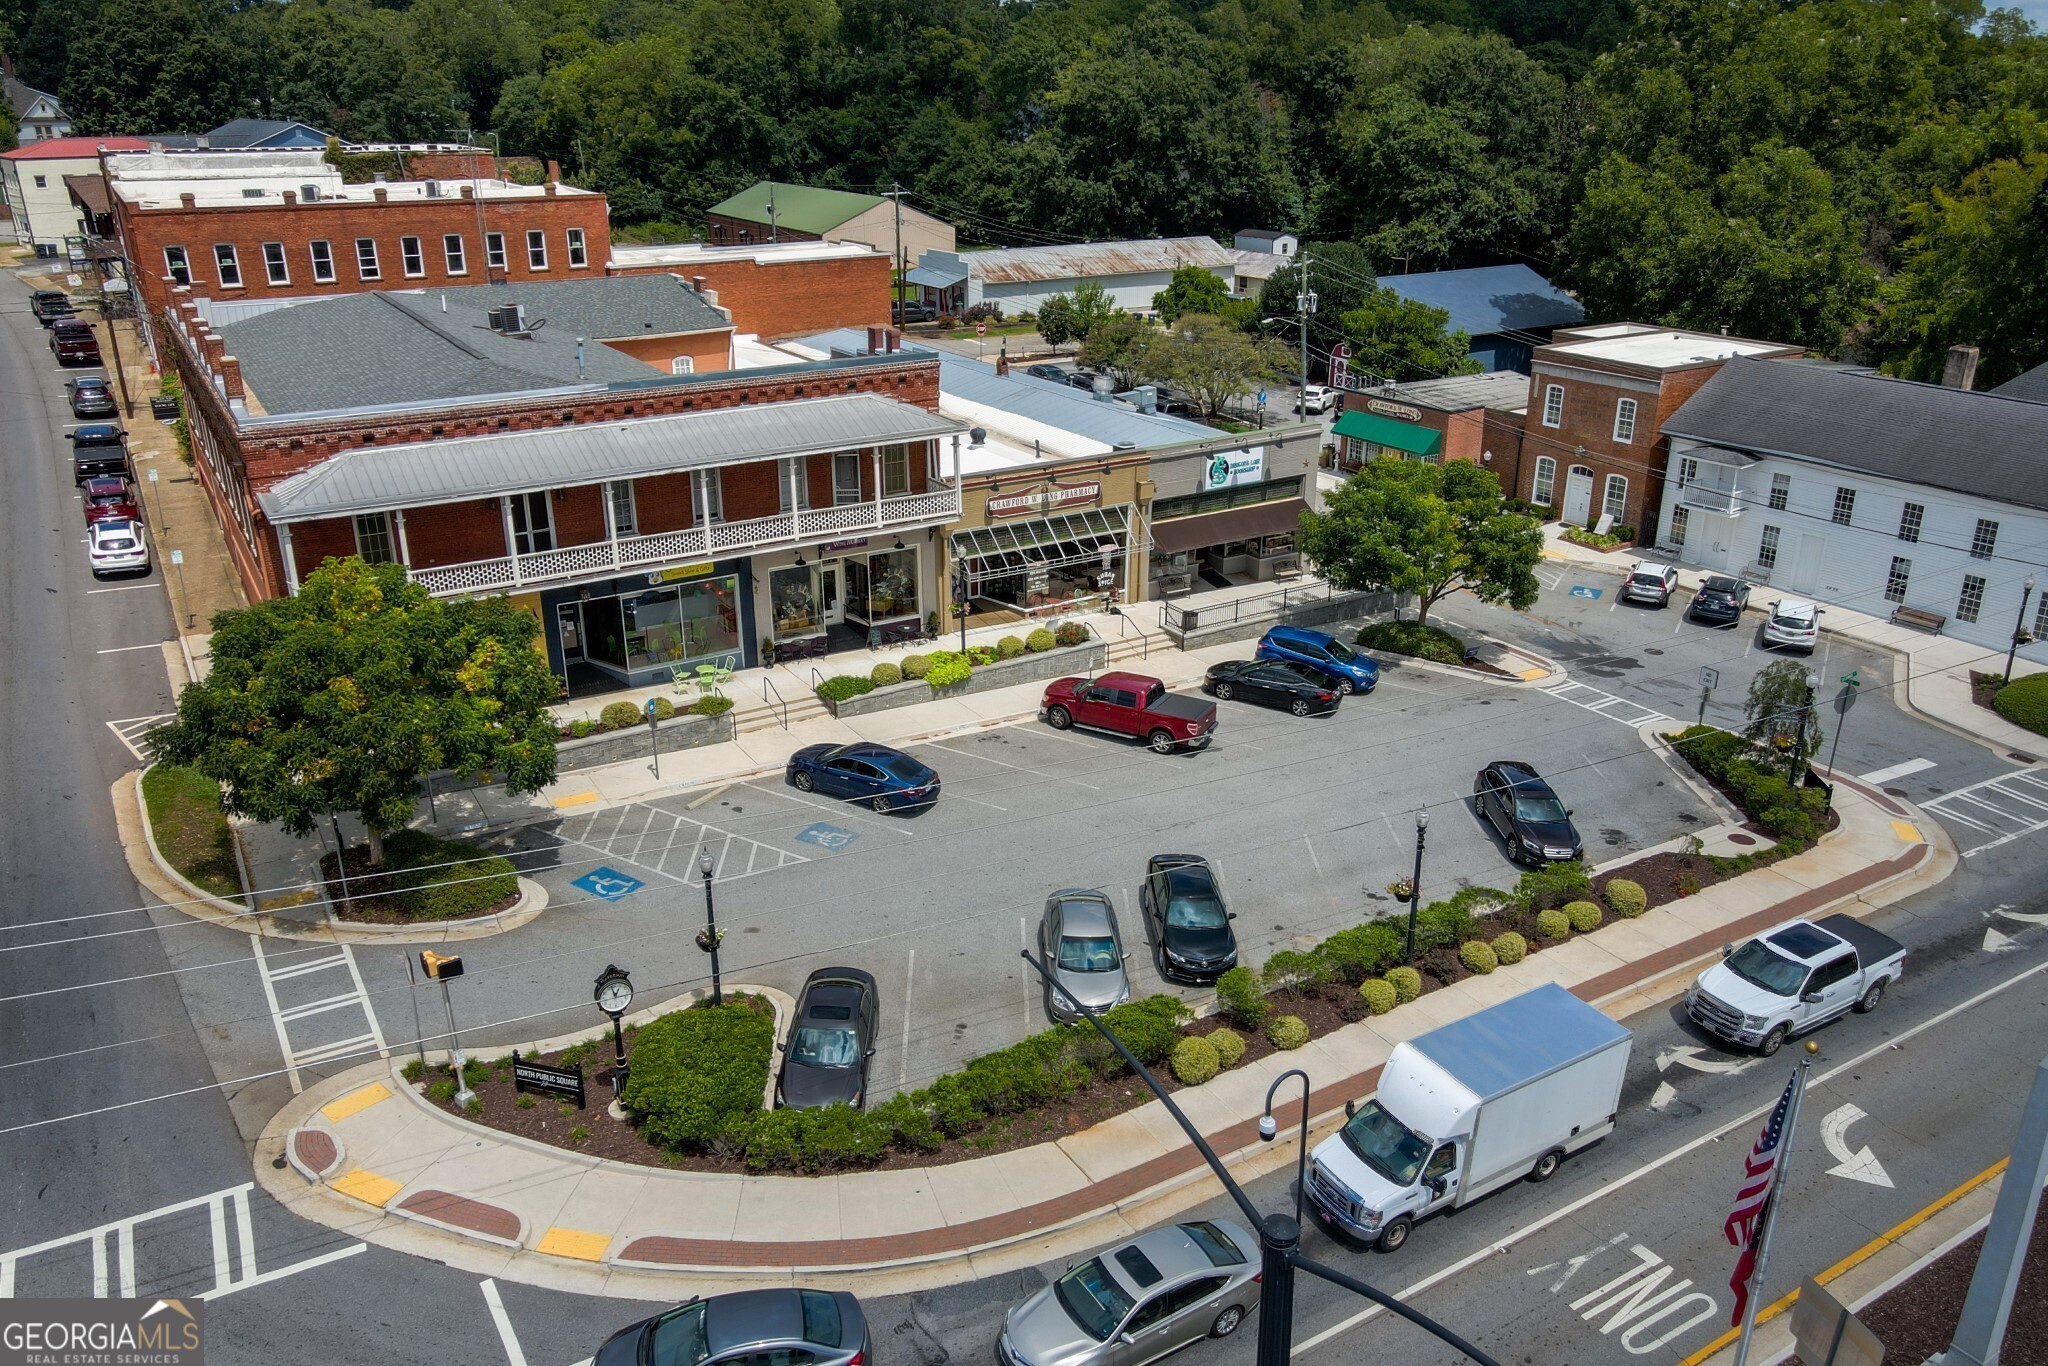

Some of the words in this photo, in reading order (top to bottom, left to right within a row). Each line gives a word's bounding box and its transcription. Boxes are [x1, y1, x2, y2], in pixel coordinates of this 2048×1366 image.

[992, 496, 1029, 510] CRAWFORD
[1032, 495, 1039, 503] W.
[1041, 492, 1058, 502] LONG
[1060, 486, 1096, 499] PHARMACY
[516, 1068, 535, 1079] NORTH
[536, 1072, 556, 1083] PUBLIC
[556, 1076, 579, 1088] SQUARE
[1526, 1232, 1718, 1355] ONLY
